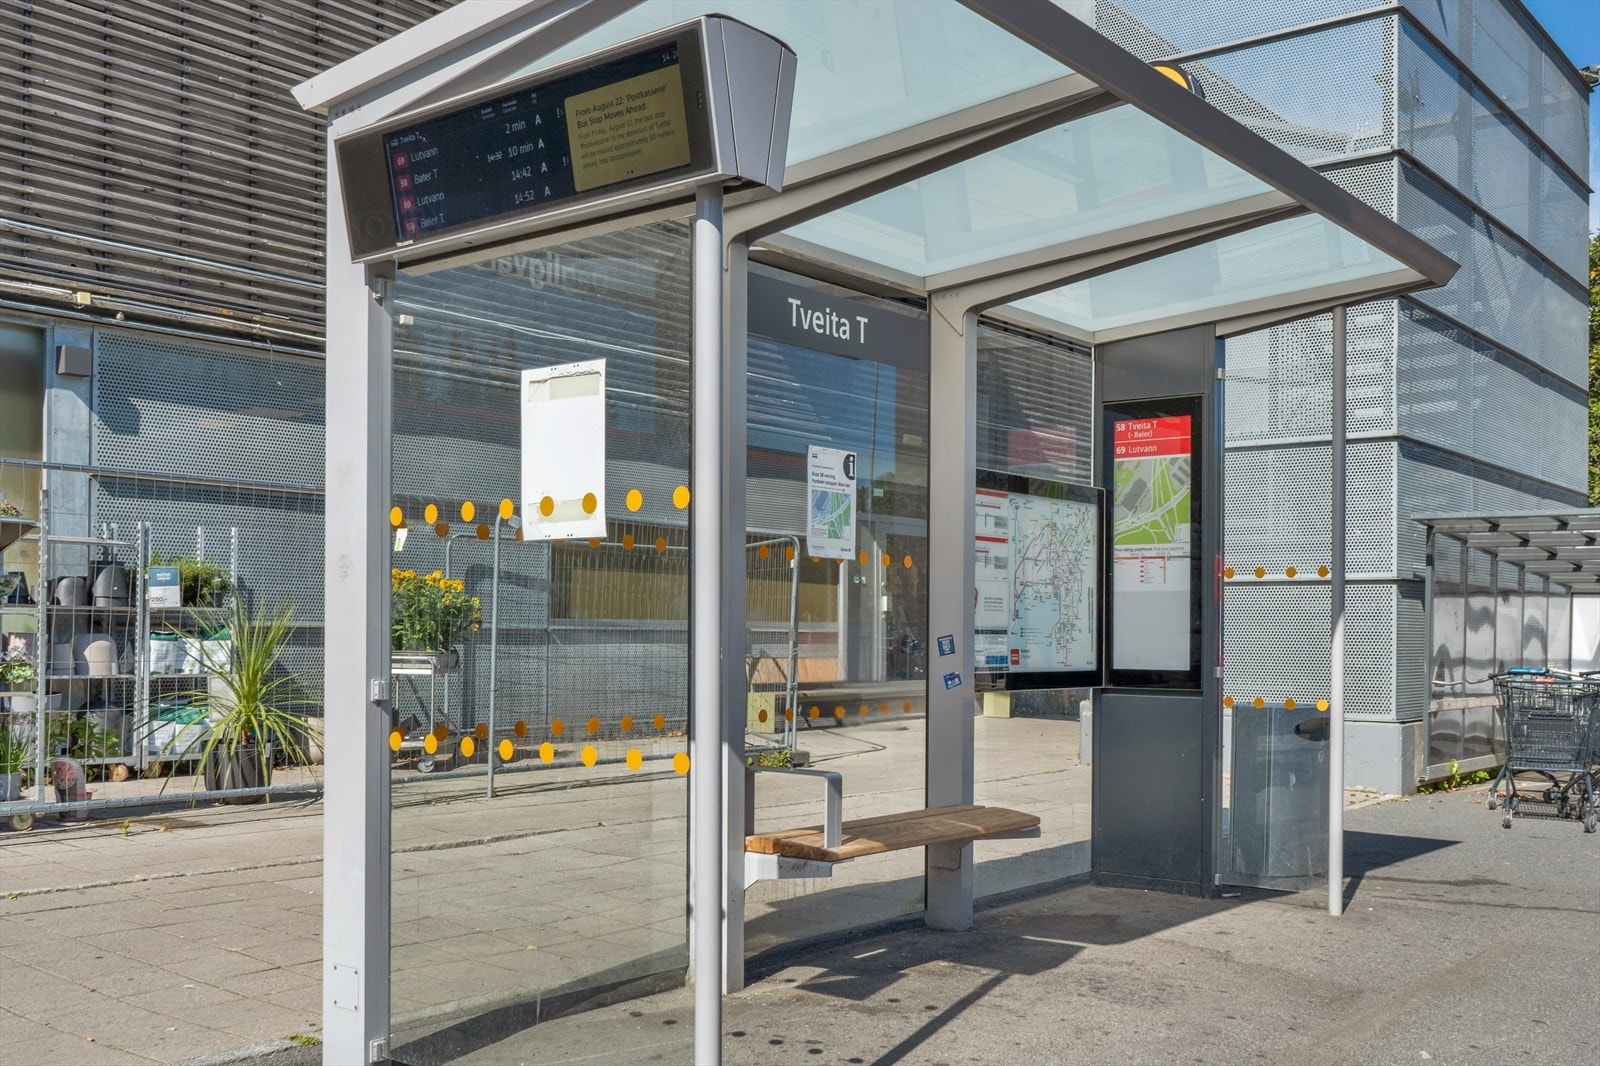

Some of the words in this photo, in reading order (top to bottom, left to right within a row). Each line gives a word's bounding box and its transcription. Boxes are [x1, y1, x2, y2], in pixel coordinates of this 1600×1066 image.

[575, 108, 591, 118] From
[592, 101, 613, 112] August
[577, 120, 588, 129] Bus
[589, 116, 603, 126] Stop
[604, 110, 624, 120] Moves
[625, 102, 648, 114] Ahead.
[400, 134, 416, 144] Tveita
[578, 132, 591, 140] From
[609, 123, 625, 132] August
[655, 111, 666, 119] stop
[626, 127, 648, 137] direction
[648, 123, 654, 132] of
[655, 120, 670, 129] Tveita
[397, 157, 404, 166] 69
[410, 147, 439, 162] Lutvann
[505, 124, 510, 134] 2
[512, 120, 526, 132] min
[535, 114, 542, 125] A
[597, 146, 614, 155] moved
[614, 137, 649, 151] approximately
[400, 179, 408, 188] 58
[433, 169, 438, 178] T
[508, 146, 518, 157] 10
[520, 142, 534, 154] min
[538, 138, 545, 149] A
[404, 200, 411, 209] 69
[417, 192, 445, 206] Lutvann
[512, 166, 532, 181] 14:42
[541, 162, 548, 173] A
[420, 216, 438, 228] Bøler
[439, 213, 445, 223] T
[514, 190, 535, 204] 14:52
[545, 186, 551, 196] A
[788, 297, 850, 340] Tveita
[856, 316, 868, 344] T
[1128, 422, 1150, 430] Tveita
[1128, 445, 1157, 453] Lutvann
